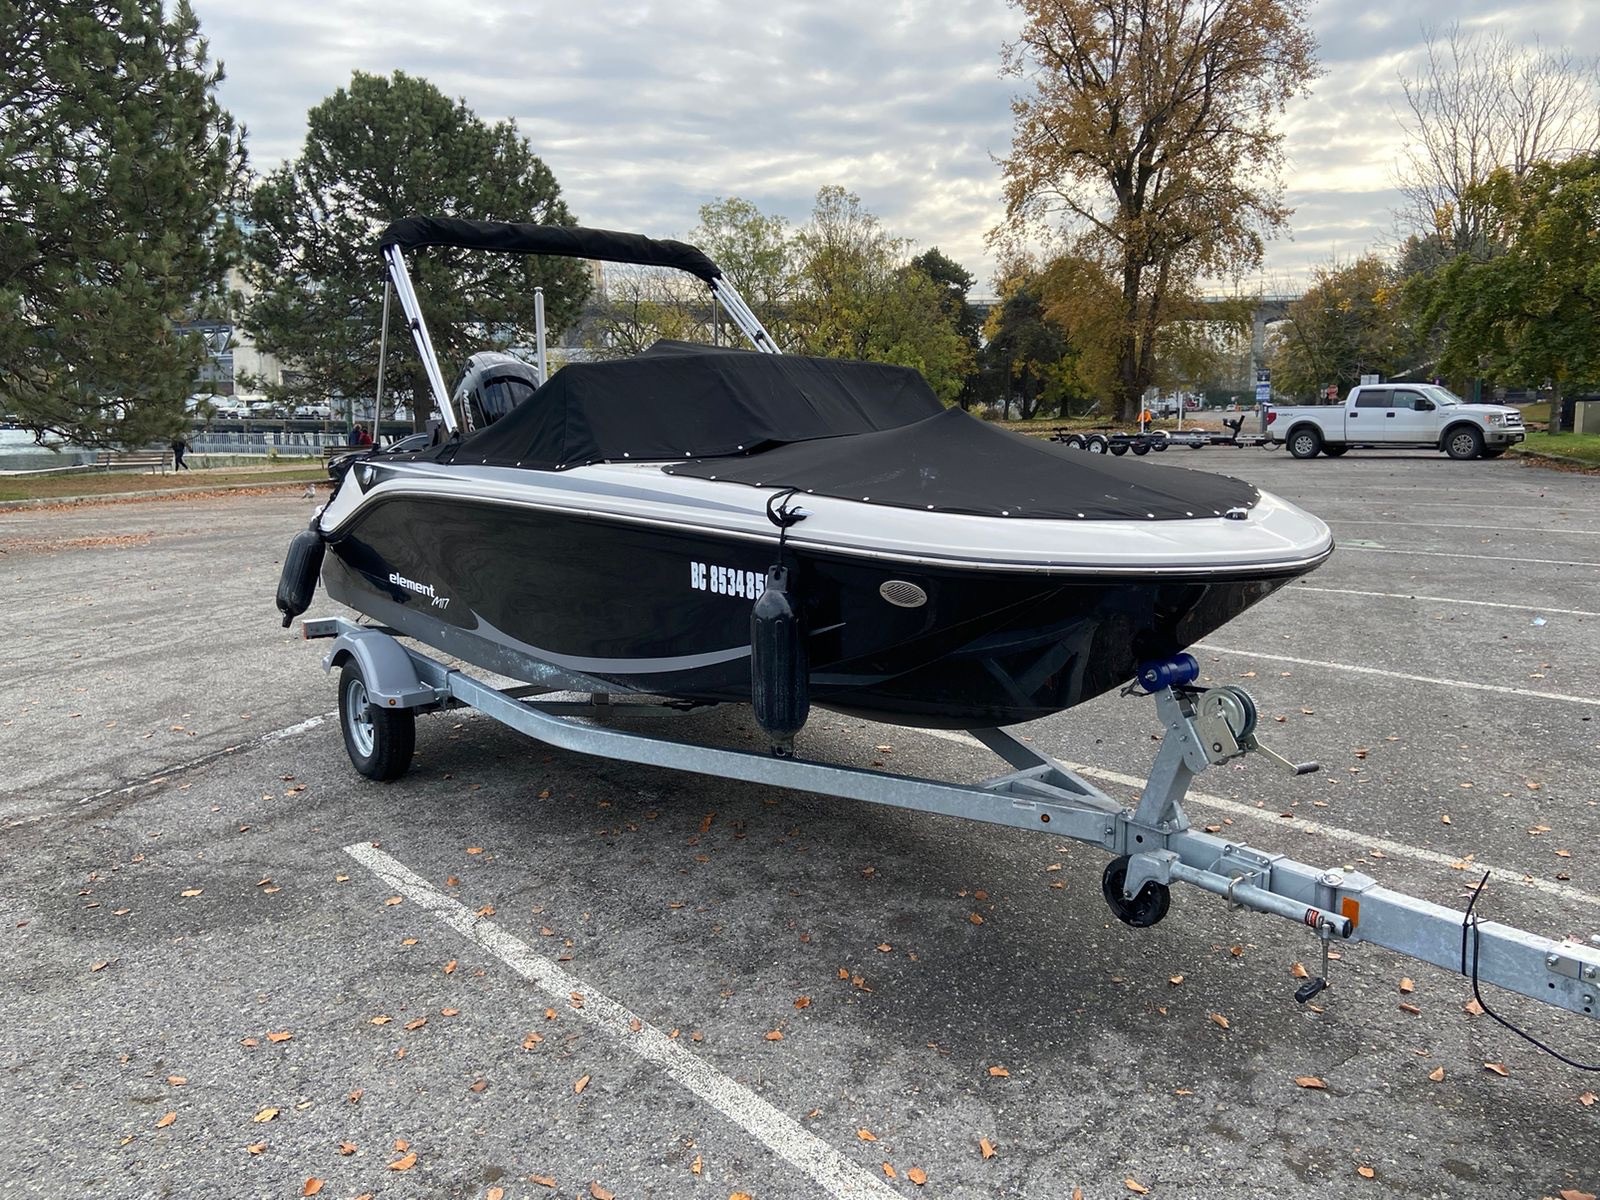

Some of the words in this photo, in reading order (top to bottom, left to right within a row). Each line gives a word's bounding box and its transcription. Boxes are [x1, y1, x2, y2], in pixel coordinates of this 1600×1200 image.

[389, 572, 435, 598] element
[690, 561, 706, 591] BC
[710, 565, 769, 600] 853485
